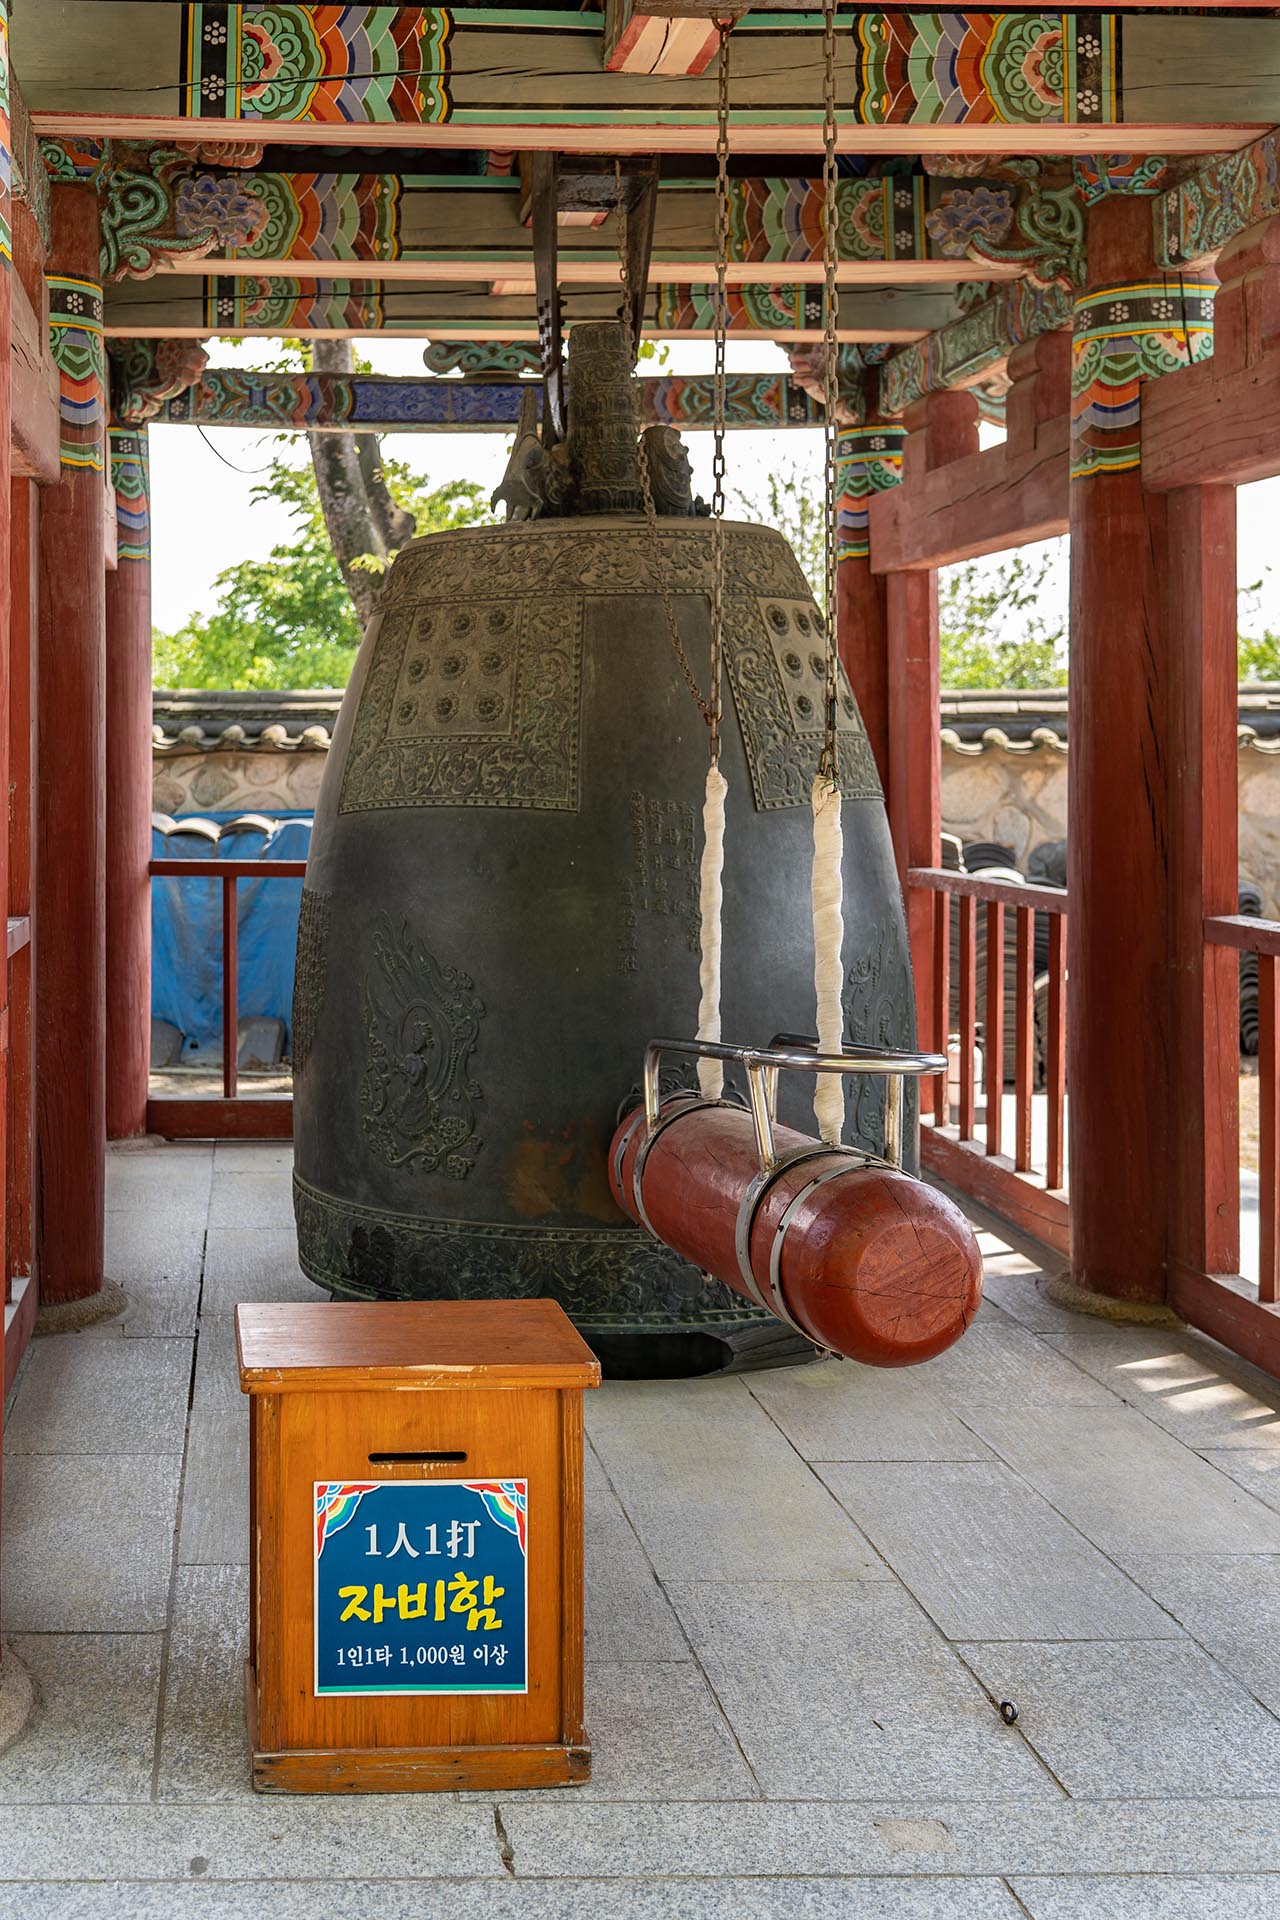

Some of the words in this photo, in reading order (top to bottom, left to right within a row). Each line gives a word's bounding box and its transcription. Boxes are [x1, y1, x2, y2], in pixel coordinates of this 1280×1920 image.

[365, 1519, 482, 1558] 1人1打
[338, 1571, 505, 1631] 자비함
[336, 1645, 393, 1667] 1인1타
[399, 1644, 466, 1667] 1,000원
[472, 1643, 509, 1666] 이상
